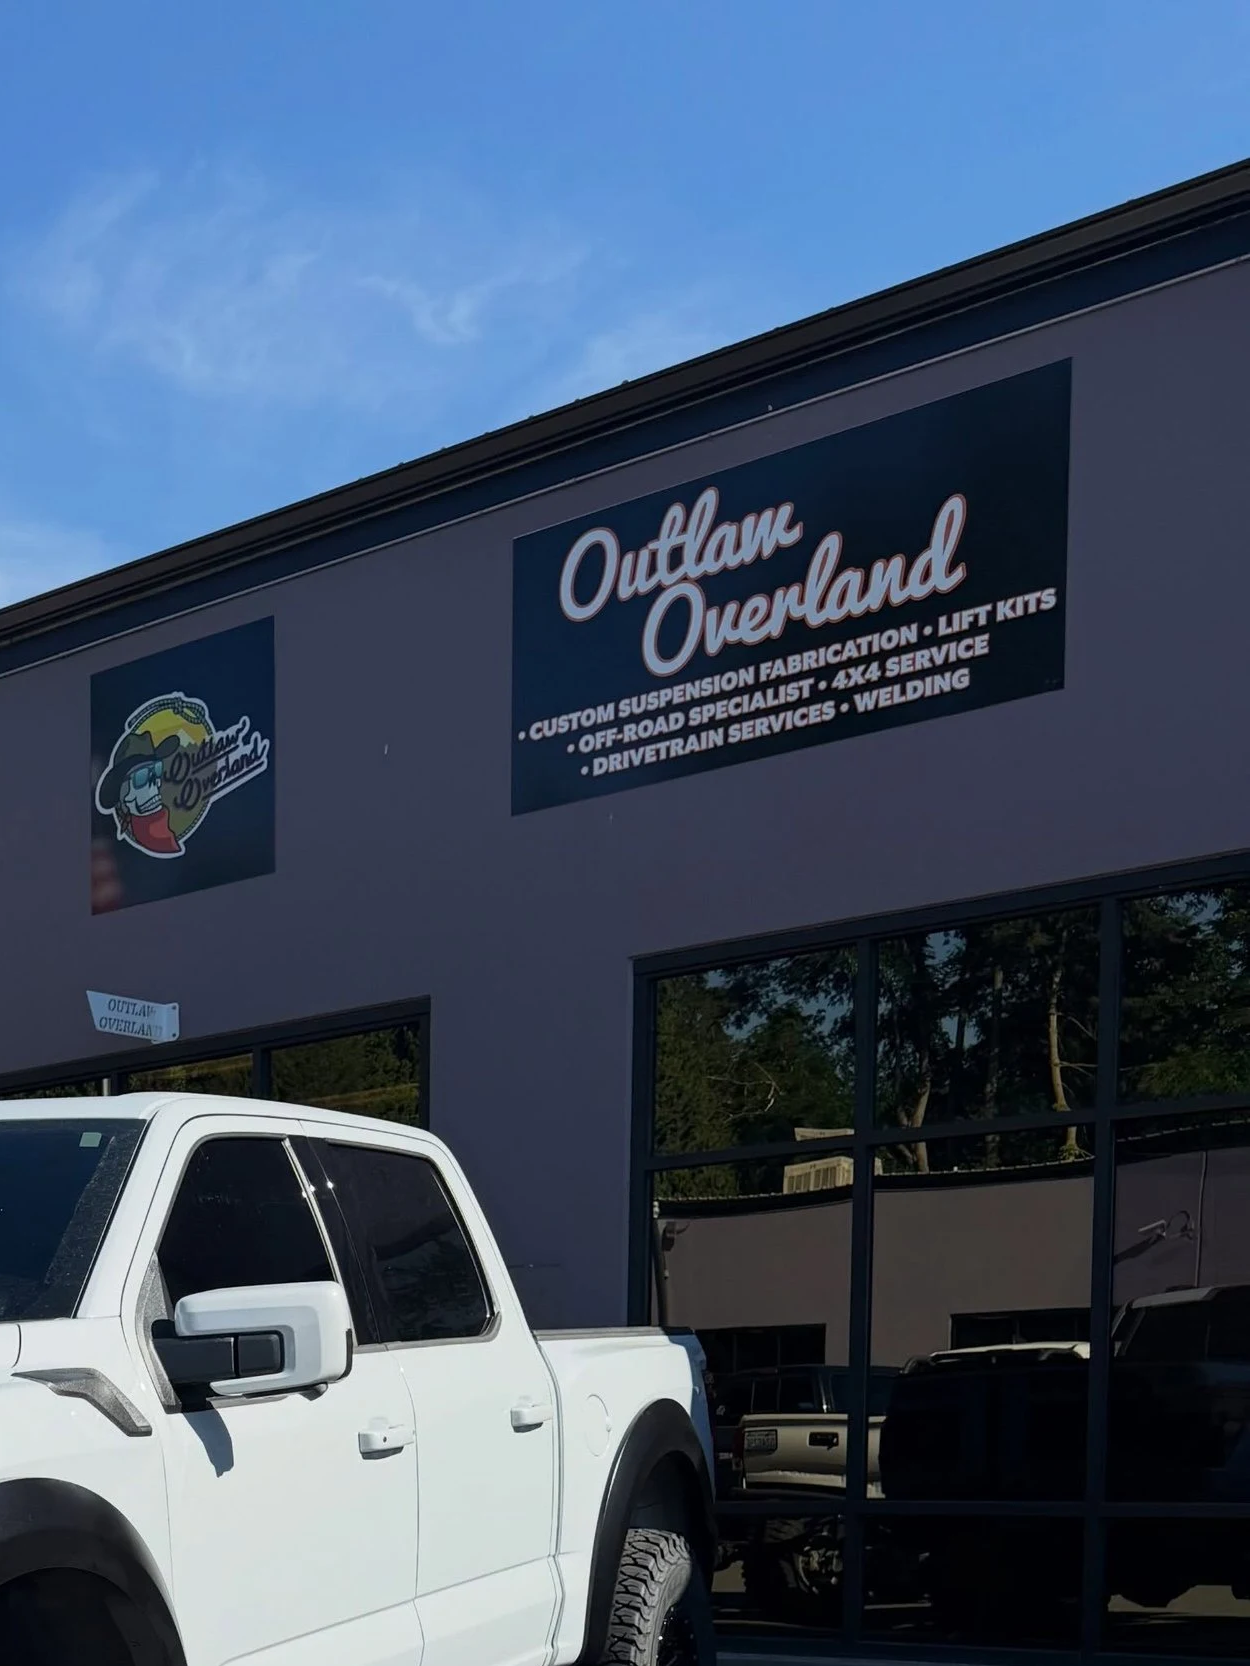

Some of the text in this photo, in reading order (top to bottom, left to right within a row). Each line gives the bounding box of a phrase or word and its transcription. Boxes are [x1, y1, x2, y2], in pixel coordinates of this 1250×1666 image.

[559, 487, 803, 621] Outlaw
[642, 494, 967, 678] Overland
[529, 588, 1057, 740] CUSTOM SUSPENSION FABRICATION LIFT KITS
[578, 633, 990, 753] OFF-ROAD SPECIALIST 4X4 SERVICE
[592, 668, 971, 777] DRIVETRAIN SERVICES WELDING
[163, 718, 247, 784] Outlaw
[173, 735, 266, 810] Overland
